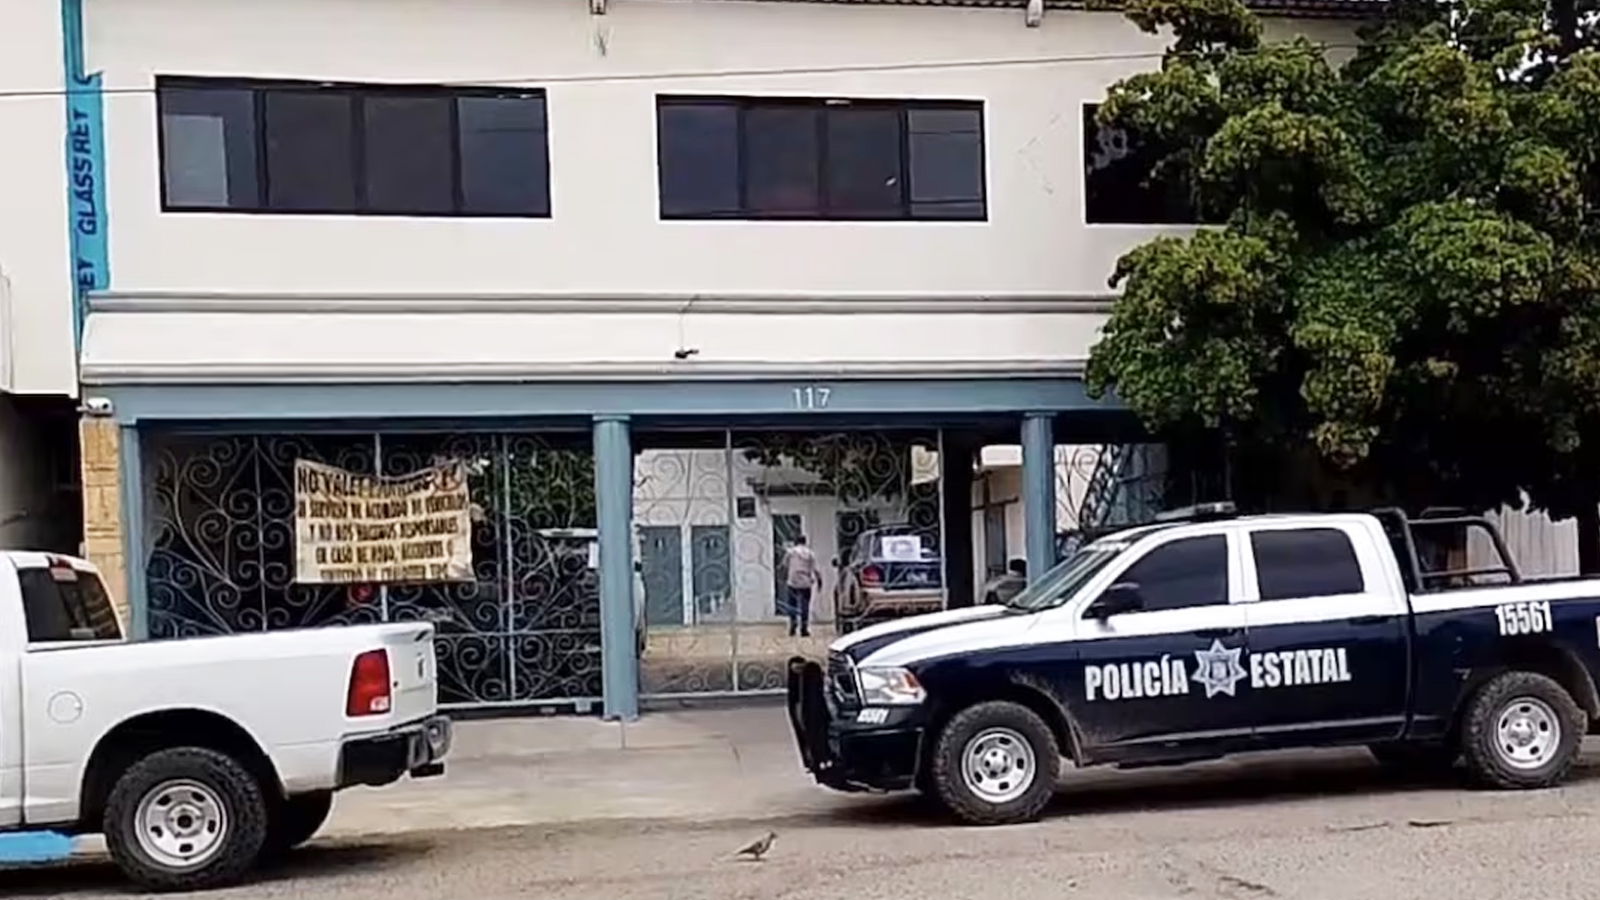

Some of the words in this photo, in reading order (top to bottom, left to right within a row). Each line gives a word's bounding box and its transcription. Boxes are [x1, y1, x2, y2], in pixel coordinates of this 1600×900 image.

[793, 387, 830, 409] 117
[298, 466, 318, 494] NO
[1495, 601, 1553, 636] 15561
[1085, 653, 1190, 701] POLICÍA
[1249, 648, 1352, 689] ESTATAL
